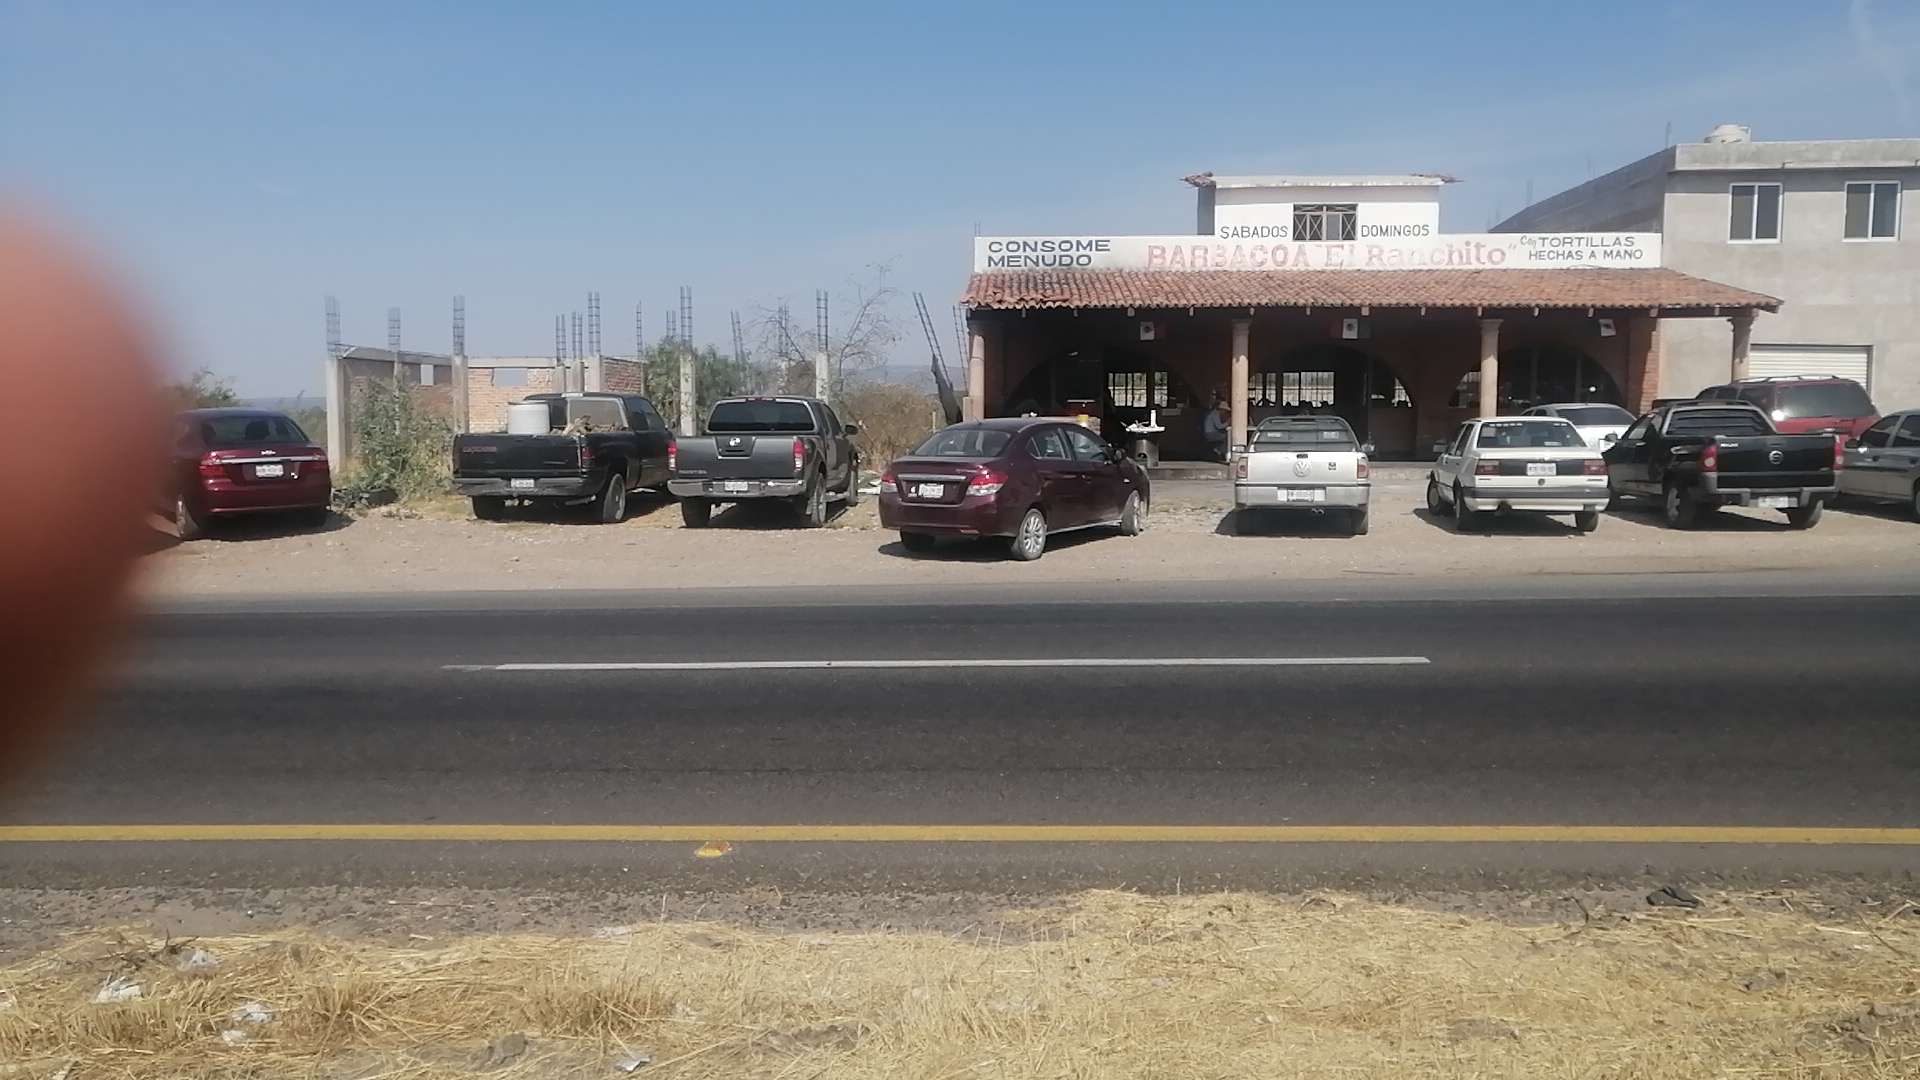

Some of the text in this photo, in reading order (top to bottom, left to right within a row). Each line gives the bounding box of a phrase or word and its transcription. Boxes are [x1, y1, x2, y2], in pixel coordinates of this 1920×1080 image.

[1220, 225, 1430, 239] SABADOS DOMINGOS
[988, 240, 1111, 252] CONSOME
[1538, 236, 1635, 248] TORTILLAS
[987, 254, 1092, 267] MENUDO
[1147, 244, 1311, 268] BARBACOA
[1529, 249, 1643, 261] HECHAS A MANO
